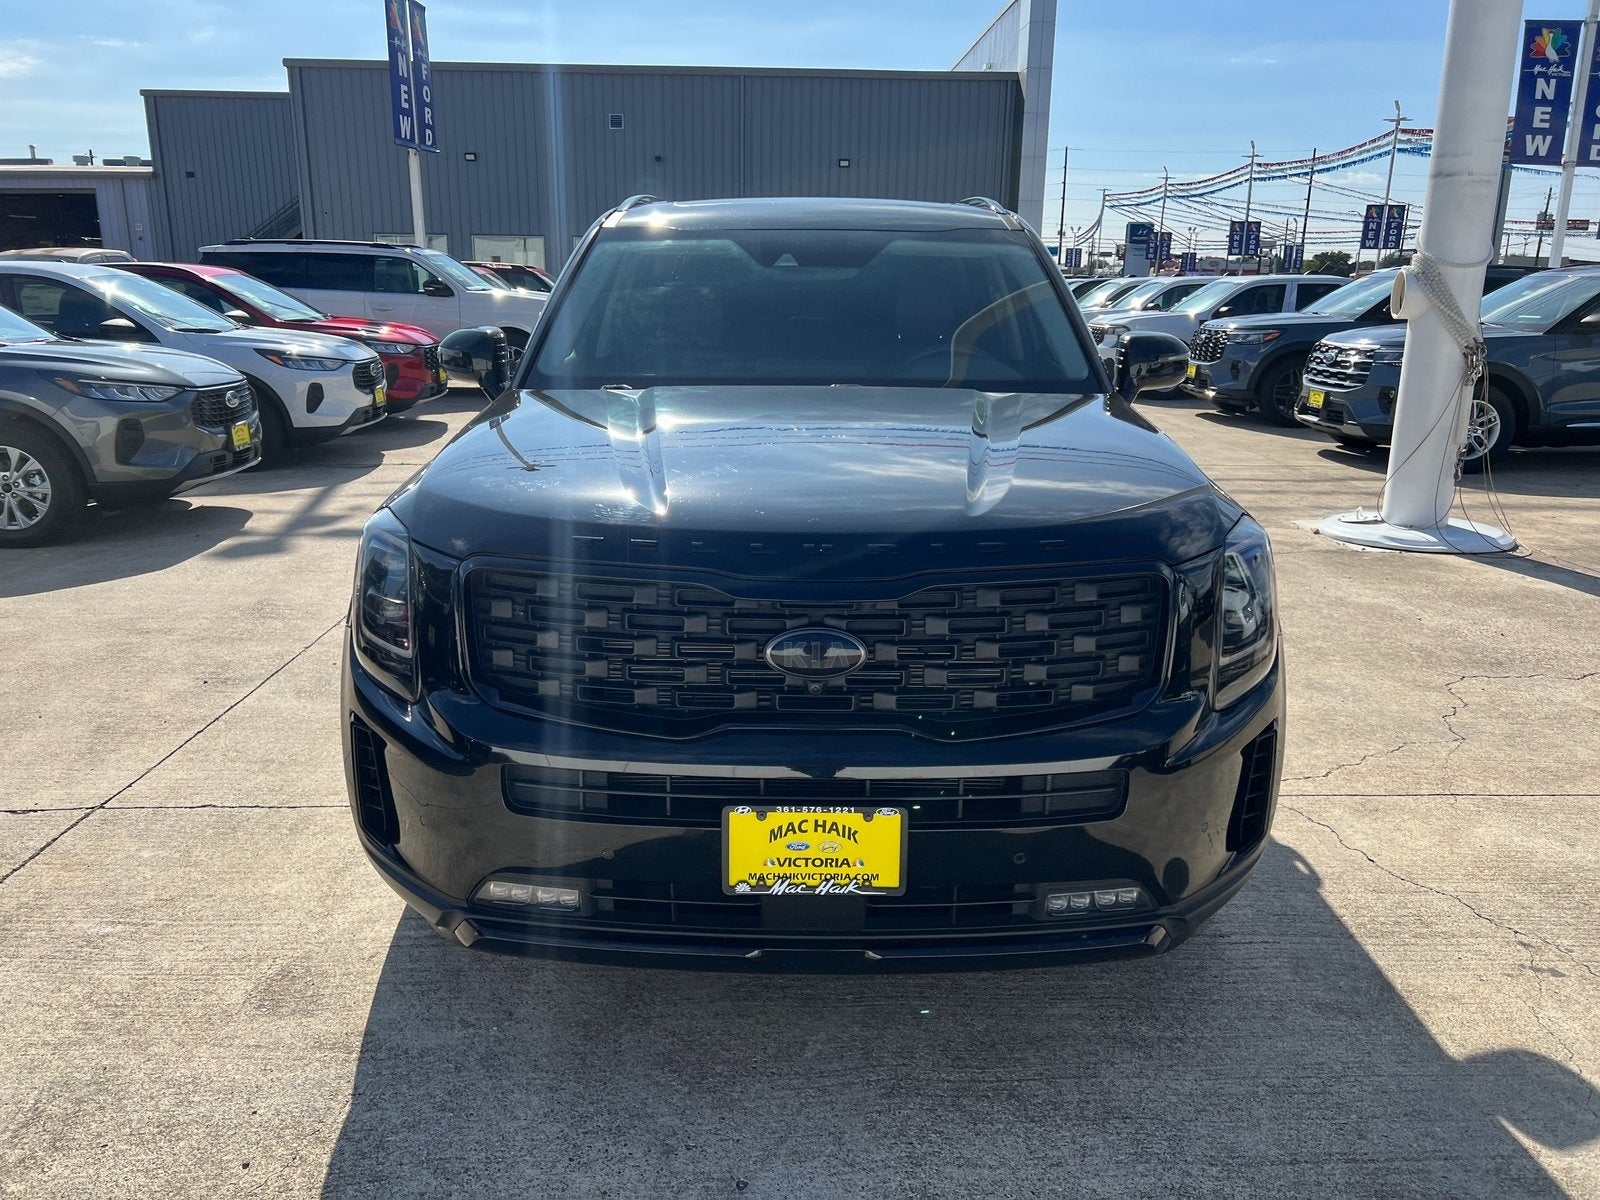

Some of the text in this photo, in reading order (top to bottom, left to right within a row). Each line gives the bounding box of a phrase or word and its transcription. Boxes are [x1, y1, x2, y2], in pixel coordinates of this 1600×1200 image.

[398, 52, 411, 139] NEW
[421, 62, 433, 146] FORD
[1525, 78, 1557, 157] NEW
[1232, 233, 1240, 255] NEW
[1249, 233, 1257, 255] FORD
[1365, 222, 1377, 248] NEW
[1388, 222, 1398, 248] FORD
[783, 641, 850, 669] KIA
[776, 806, 856, 814] 361-576-1221
[768, 819, 859, 845] MAC HAIK
[776, 857, 851, 868] VICTORIA
[748, 872, 880, 881] MACHAIKVICTORIACOM
[768, 878, 866, 895] Mac Haik
